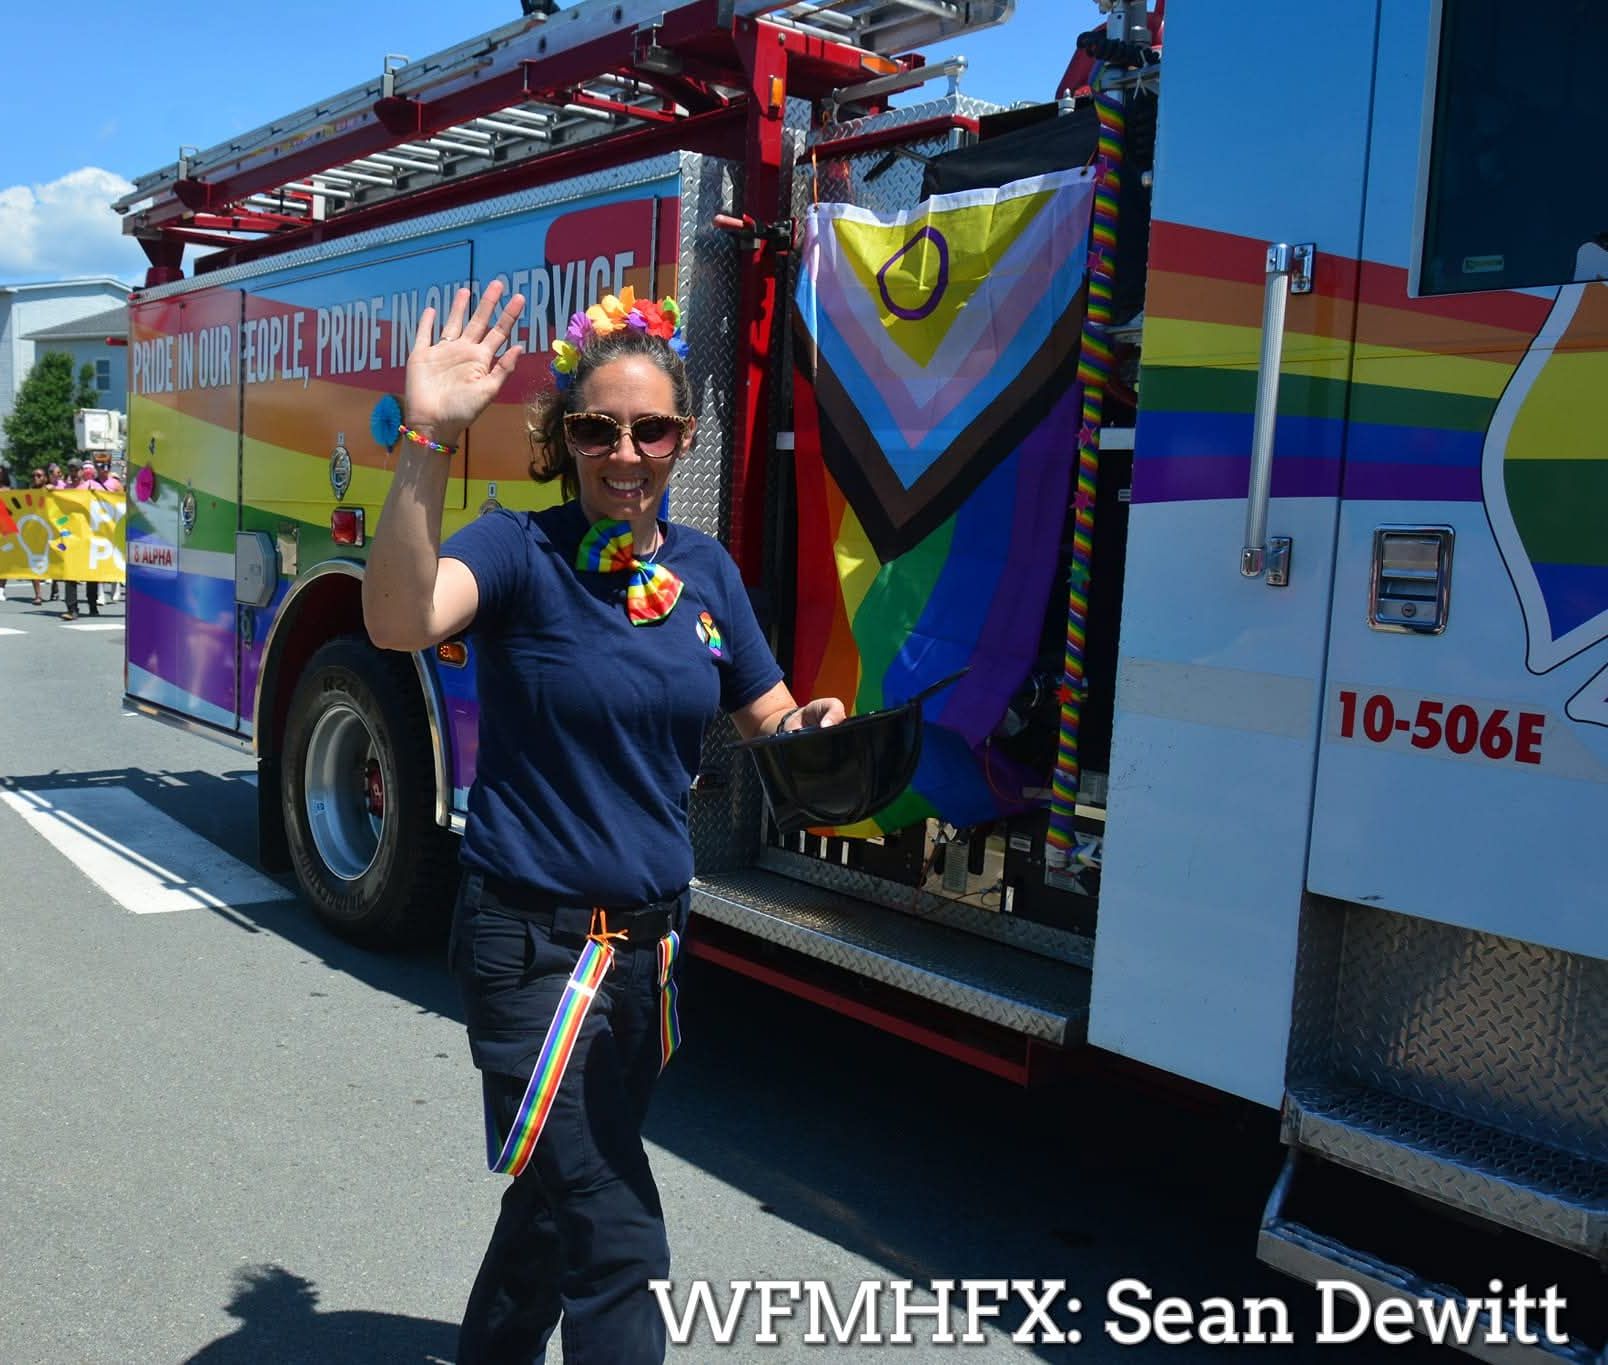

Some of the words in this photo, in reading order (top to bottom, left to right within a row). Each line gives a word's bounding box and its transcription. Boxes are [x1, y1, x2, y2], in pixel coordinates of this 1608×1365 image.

[132, 335, 174, 395] PRIDE
[178, 331, 194, 391] IN
[198, 324, 231, 389] OUR
[237, 311, 310, 389] PEOPLE,
[316, 295, 384, 377] PRIDE
[390, 288, 418, 369] IN
[142, 546, 173, 568] ALPHA
[1339, 690, 1546, 765] 10-506E
